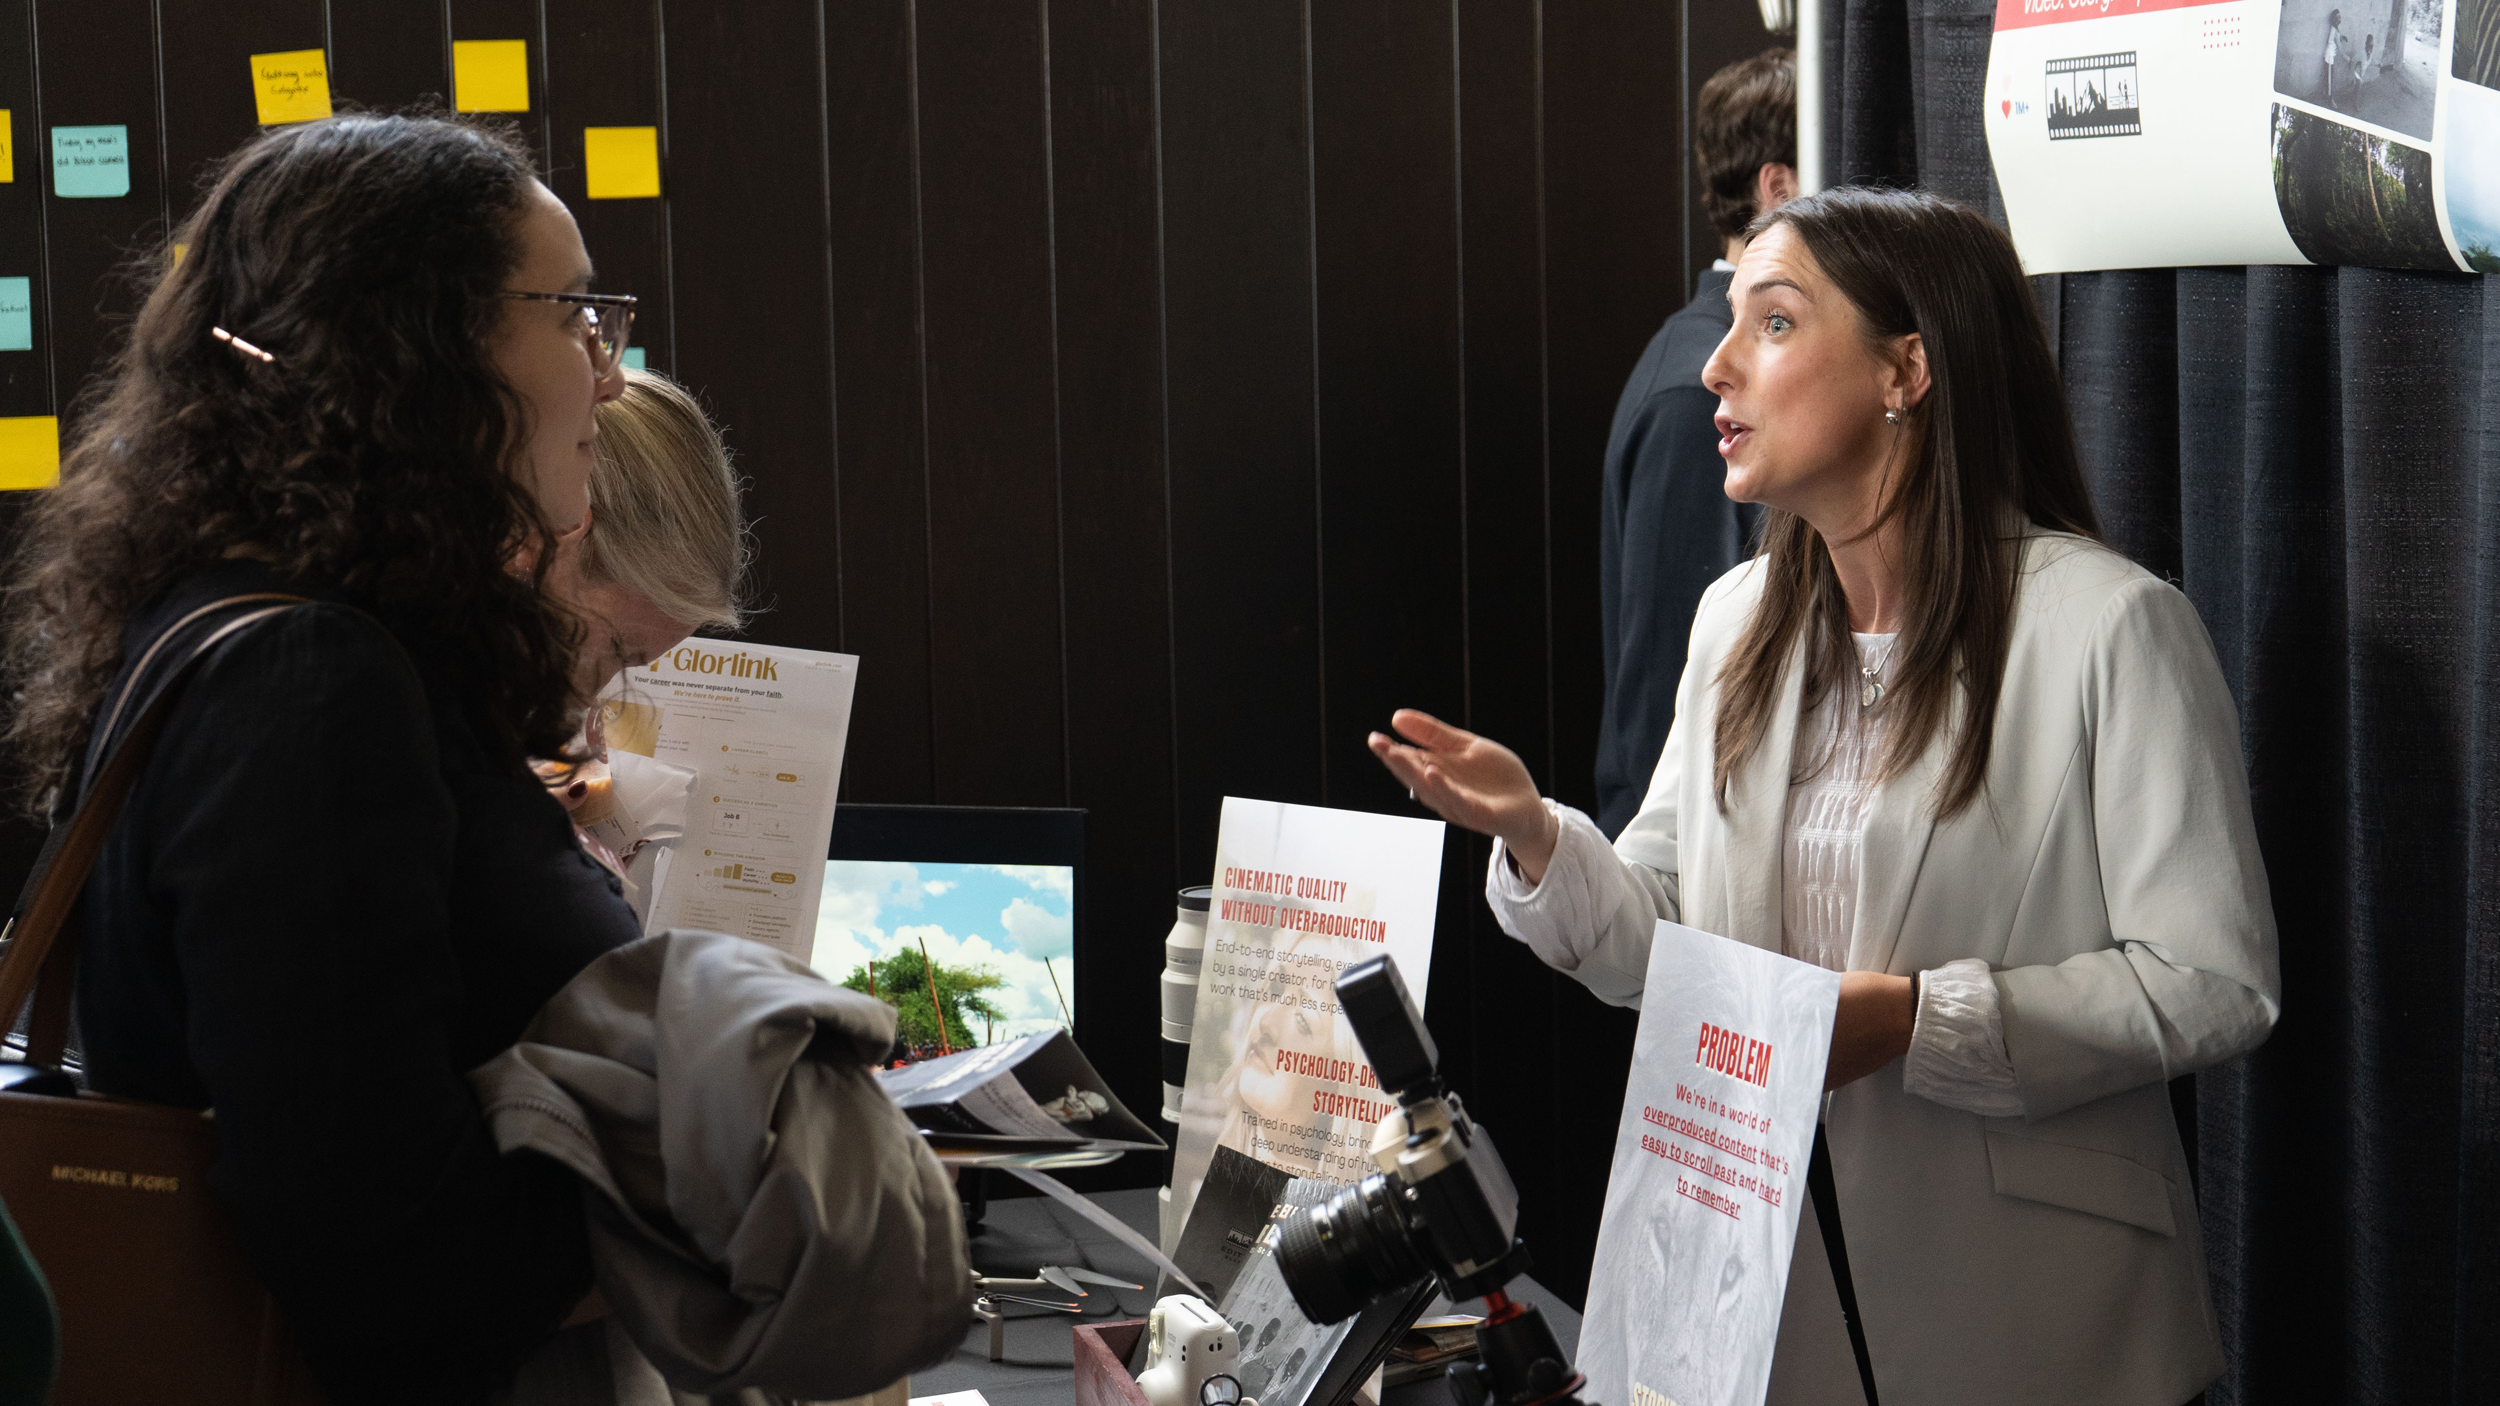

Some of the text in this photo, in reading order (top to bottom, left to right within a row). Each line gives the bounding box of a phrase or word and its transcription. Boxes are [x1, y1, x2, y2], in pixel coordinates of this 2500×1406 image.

[674, 648, 778, 681] Glorlink
[634, 675, 650, 683] Your
[705, 684, 733, 693] separate
[766, 690, 784, 698] faith.
[1225, 866, 1347, 903] CINEMATIC QUALITY
[1221, 899, 1386, 943] WITHOUT OVERPRODUCTION
[1216, 939, 1274, 960] End-to-end
[1277, 951, 1333, 972] storytelling,
[1213, 960, 1226, 976] by
[1228, 965, 1235, 975] a
[1238, 964, 1266, 982] single
[1269, 971, 1309, 989] creator,
[1312, 975, 1328, 989] for
[1210, 983, 1345, 1016] work that's much less expe
[1696, 1022, 1773, 1090] PROBLEM
[1676, 1082, 1772, 1135] We're in a world of
[1242, 1111, 1278, 1130] Trained
[1280, 1119, 1288, 1132] in
[1290, 1124, 1345, 1147] psychology,
[1644, 1105, 1789, 1175] overproduced content that's
[1251, 1136, 1275, 1150] deep
[1277, 1142, 1346, 1169] understanding
[1348, 1156, 1360, 1168] of
[1641, 1134, 1782, 1205] easy to scroll past and hard
[52, 1165, 179, 1192] MICHAEL KORS
[1677, 1175, 1741, 1216] to remember
